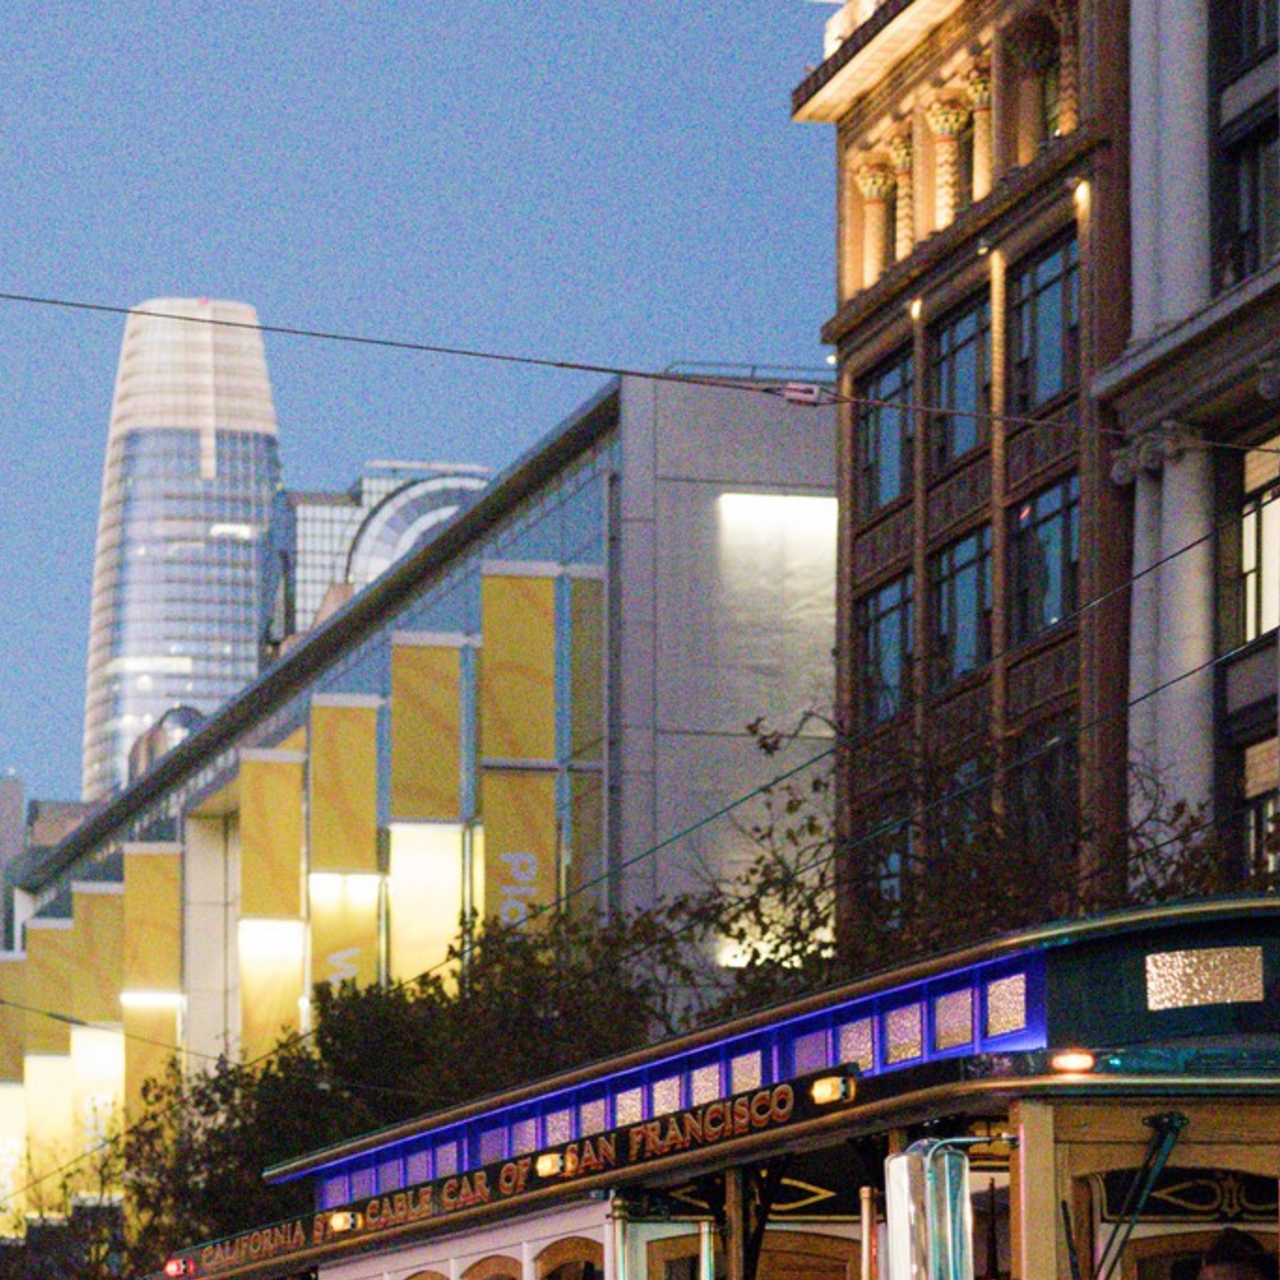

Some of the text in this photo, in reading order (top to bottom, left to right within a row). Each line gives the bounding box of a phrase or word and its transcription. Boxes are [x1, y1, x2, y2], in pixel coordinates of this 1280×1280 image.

[201, 1221, 305, 1267] CALIFORNIA
[366, 1186, 433, 1228] CABLE
[442, 1169, 489, 1209] CAR
[499, 1156, 532, 1196] OF
[565, 1132, 617, 1177] SAN
[629, 1083, 794, 1162] FRANCISCO
